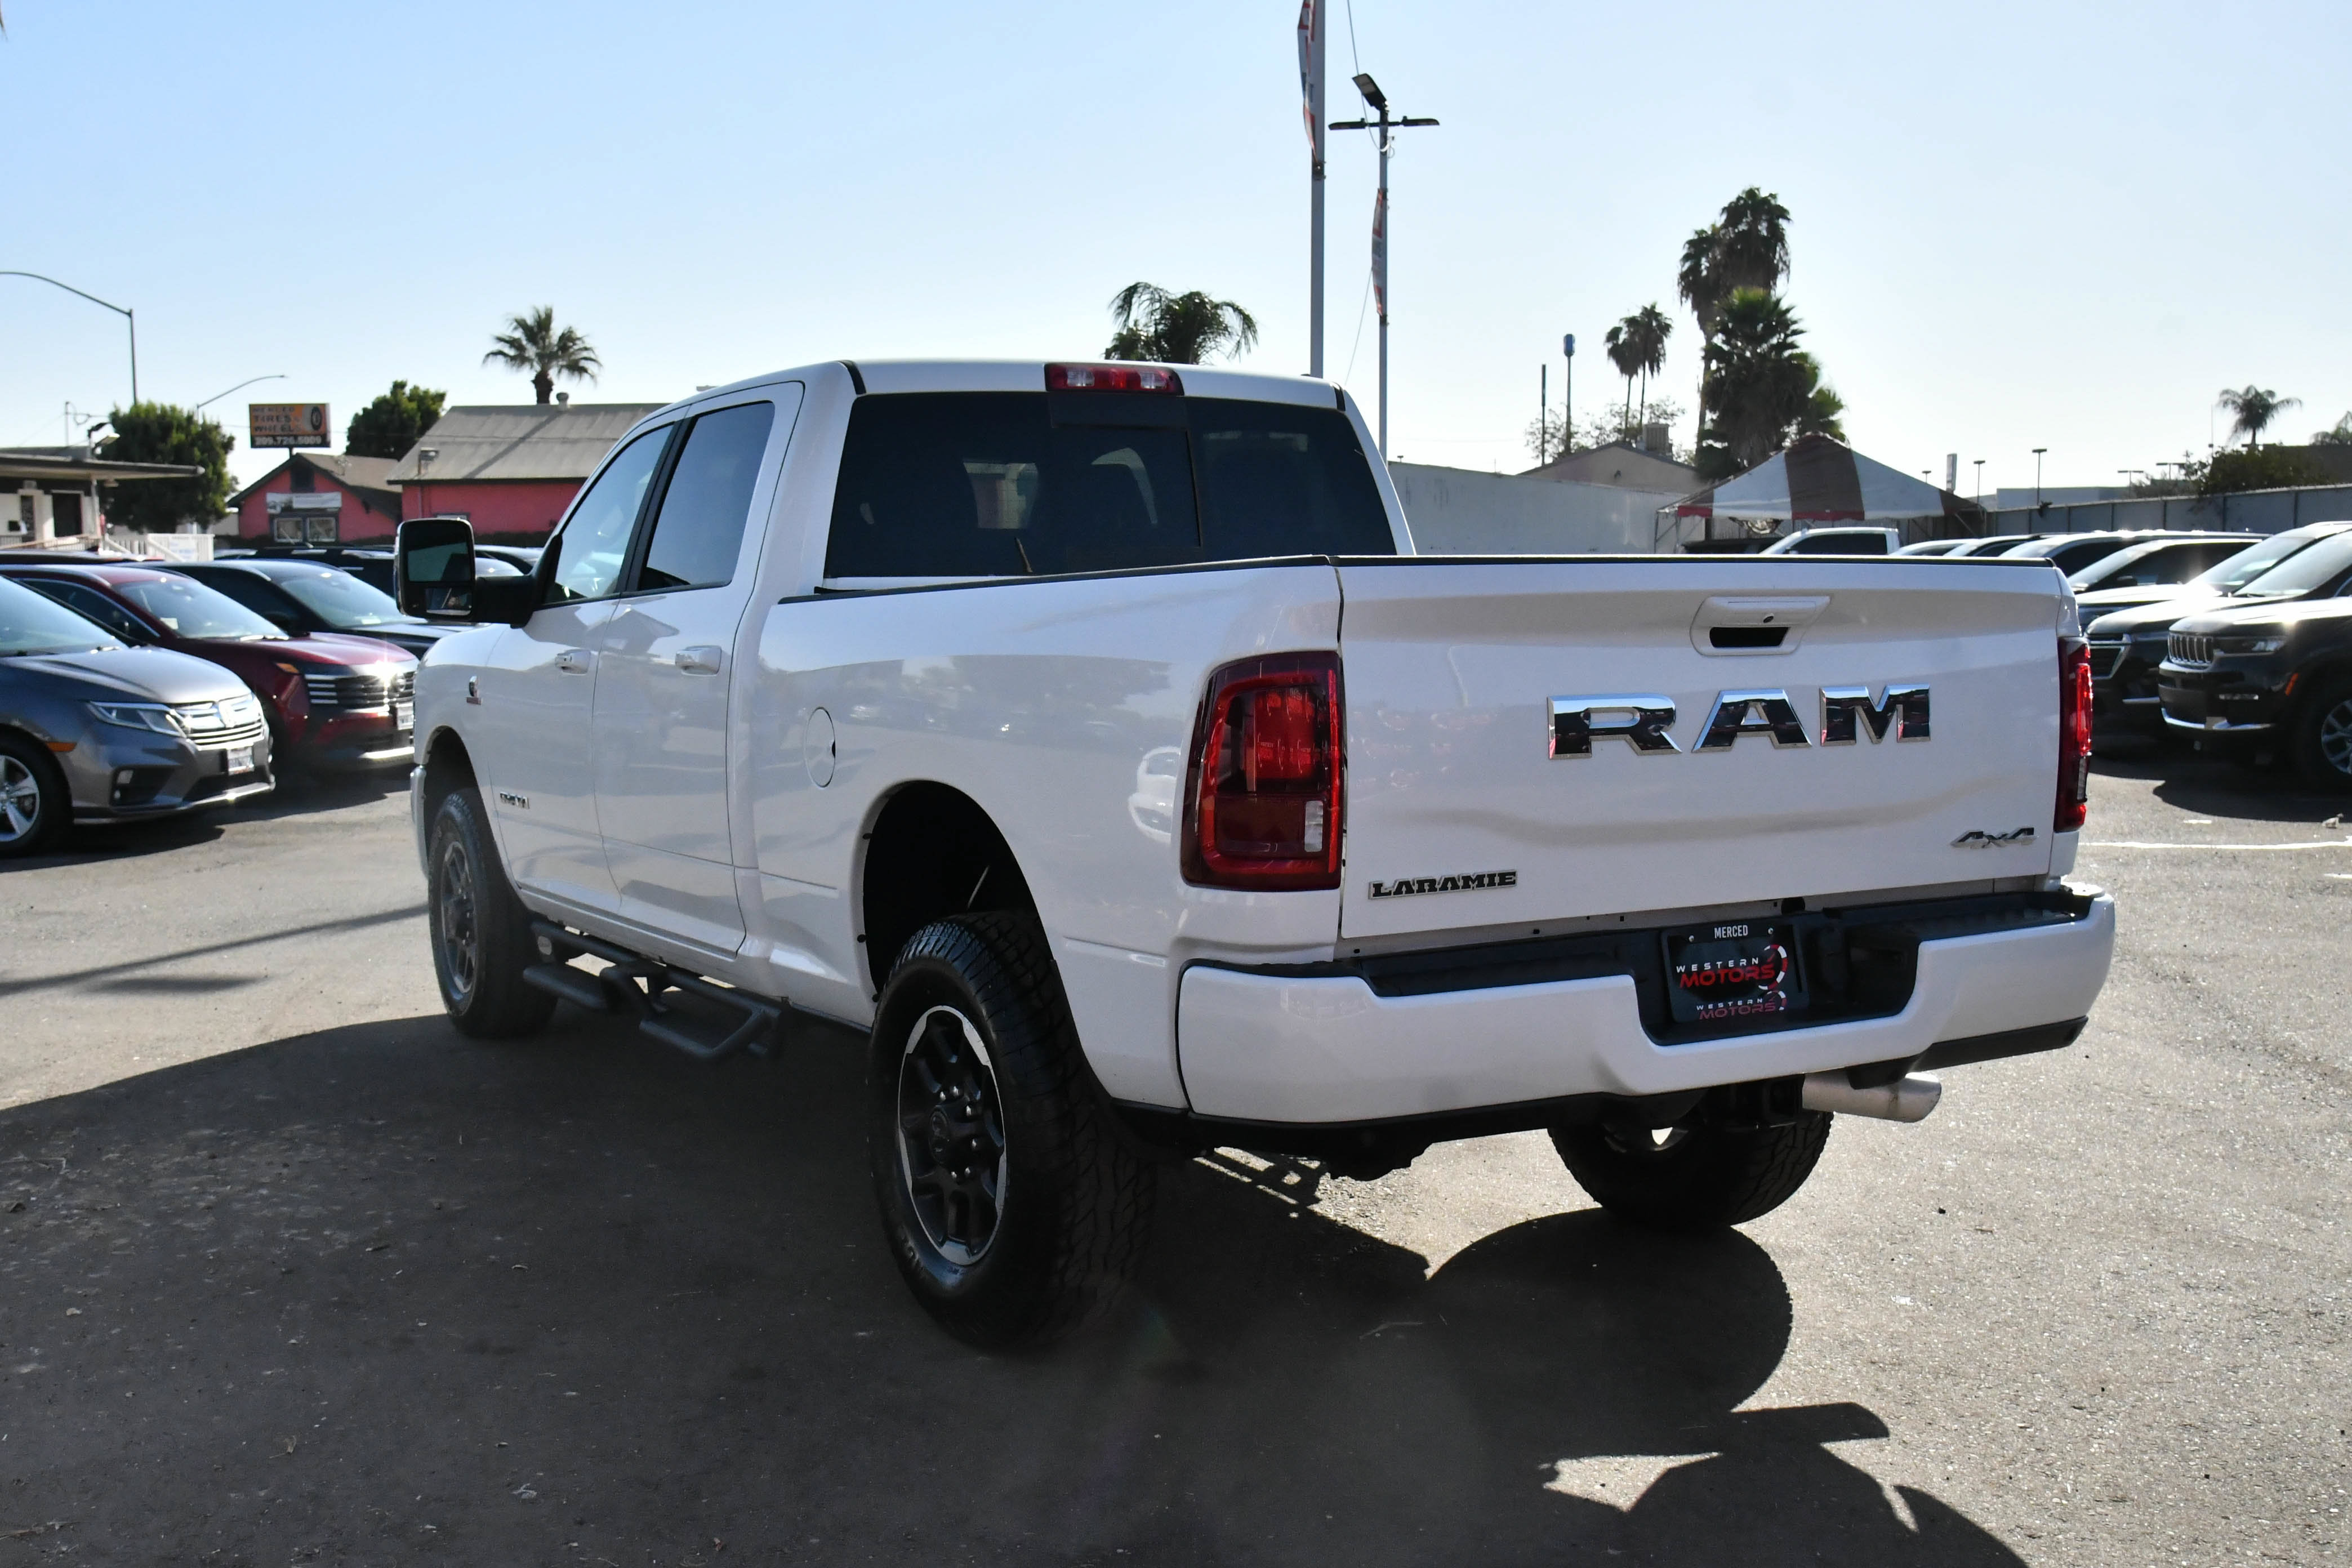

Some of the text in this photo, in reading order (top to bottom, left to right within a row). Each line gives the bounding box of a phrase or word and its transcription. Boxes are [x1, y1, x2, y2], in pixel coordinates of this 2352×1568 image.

[1548, 684, 1931, 760] RAM
[1368, 870, 1517, 899] LARAMIE
[1714, 925, 1748, 939] MERCED
[1676, 957, 1759, 973] WESTERN
[1680, 963, 1775, 989] MOTORS
[1696, 998, 1762, 1010] WESTERN
[1699, 1001, 1775, 1020] MOTORS
